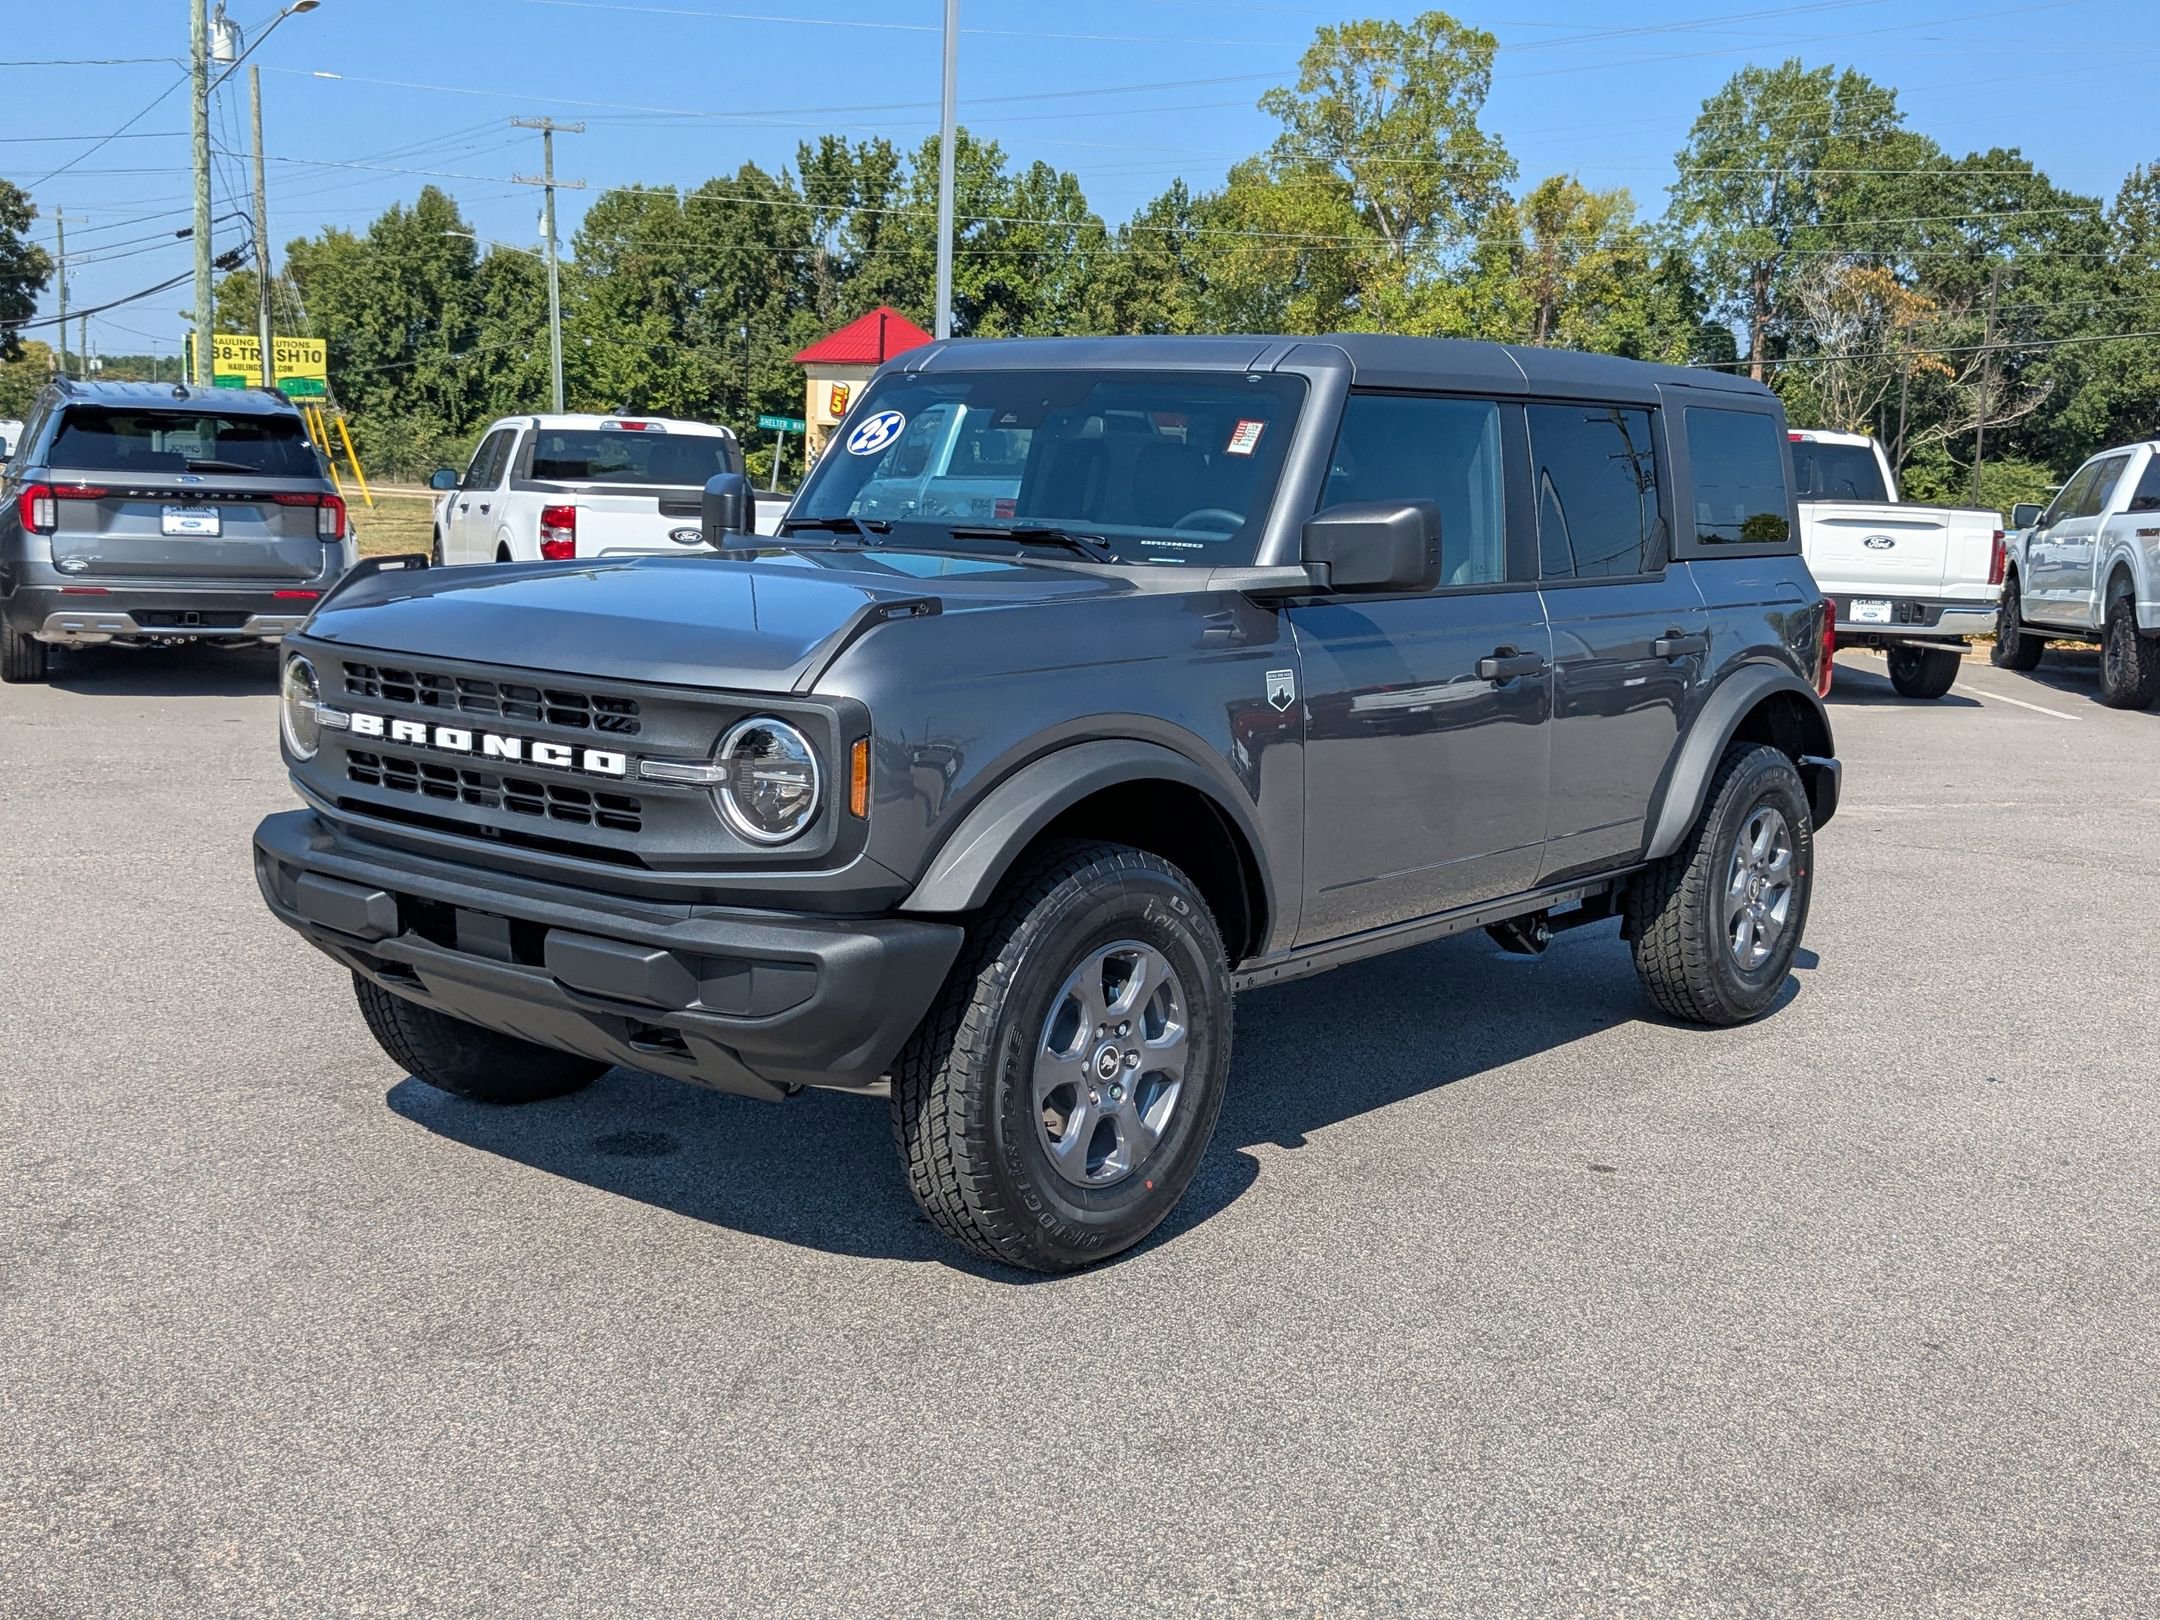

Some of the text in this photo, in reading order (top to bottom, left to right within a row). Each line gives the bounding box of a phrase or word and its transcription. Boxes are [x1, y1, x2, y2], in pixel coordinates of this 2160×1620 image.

[832, 395, 843, 413] 5
[760, 417, 806, 431] SHELTER WAY
[851, 415, 900, 451] 25
[1141, 540, 1204, 549] BRONCO
[351, 712, 626, 775] BRONCO
